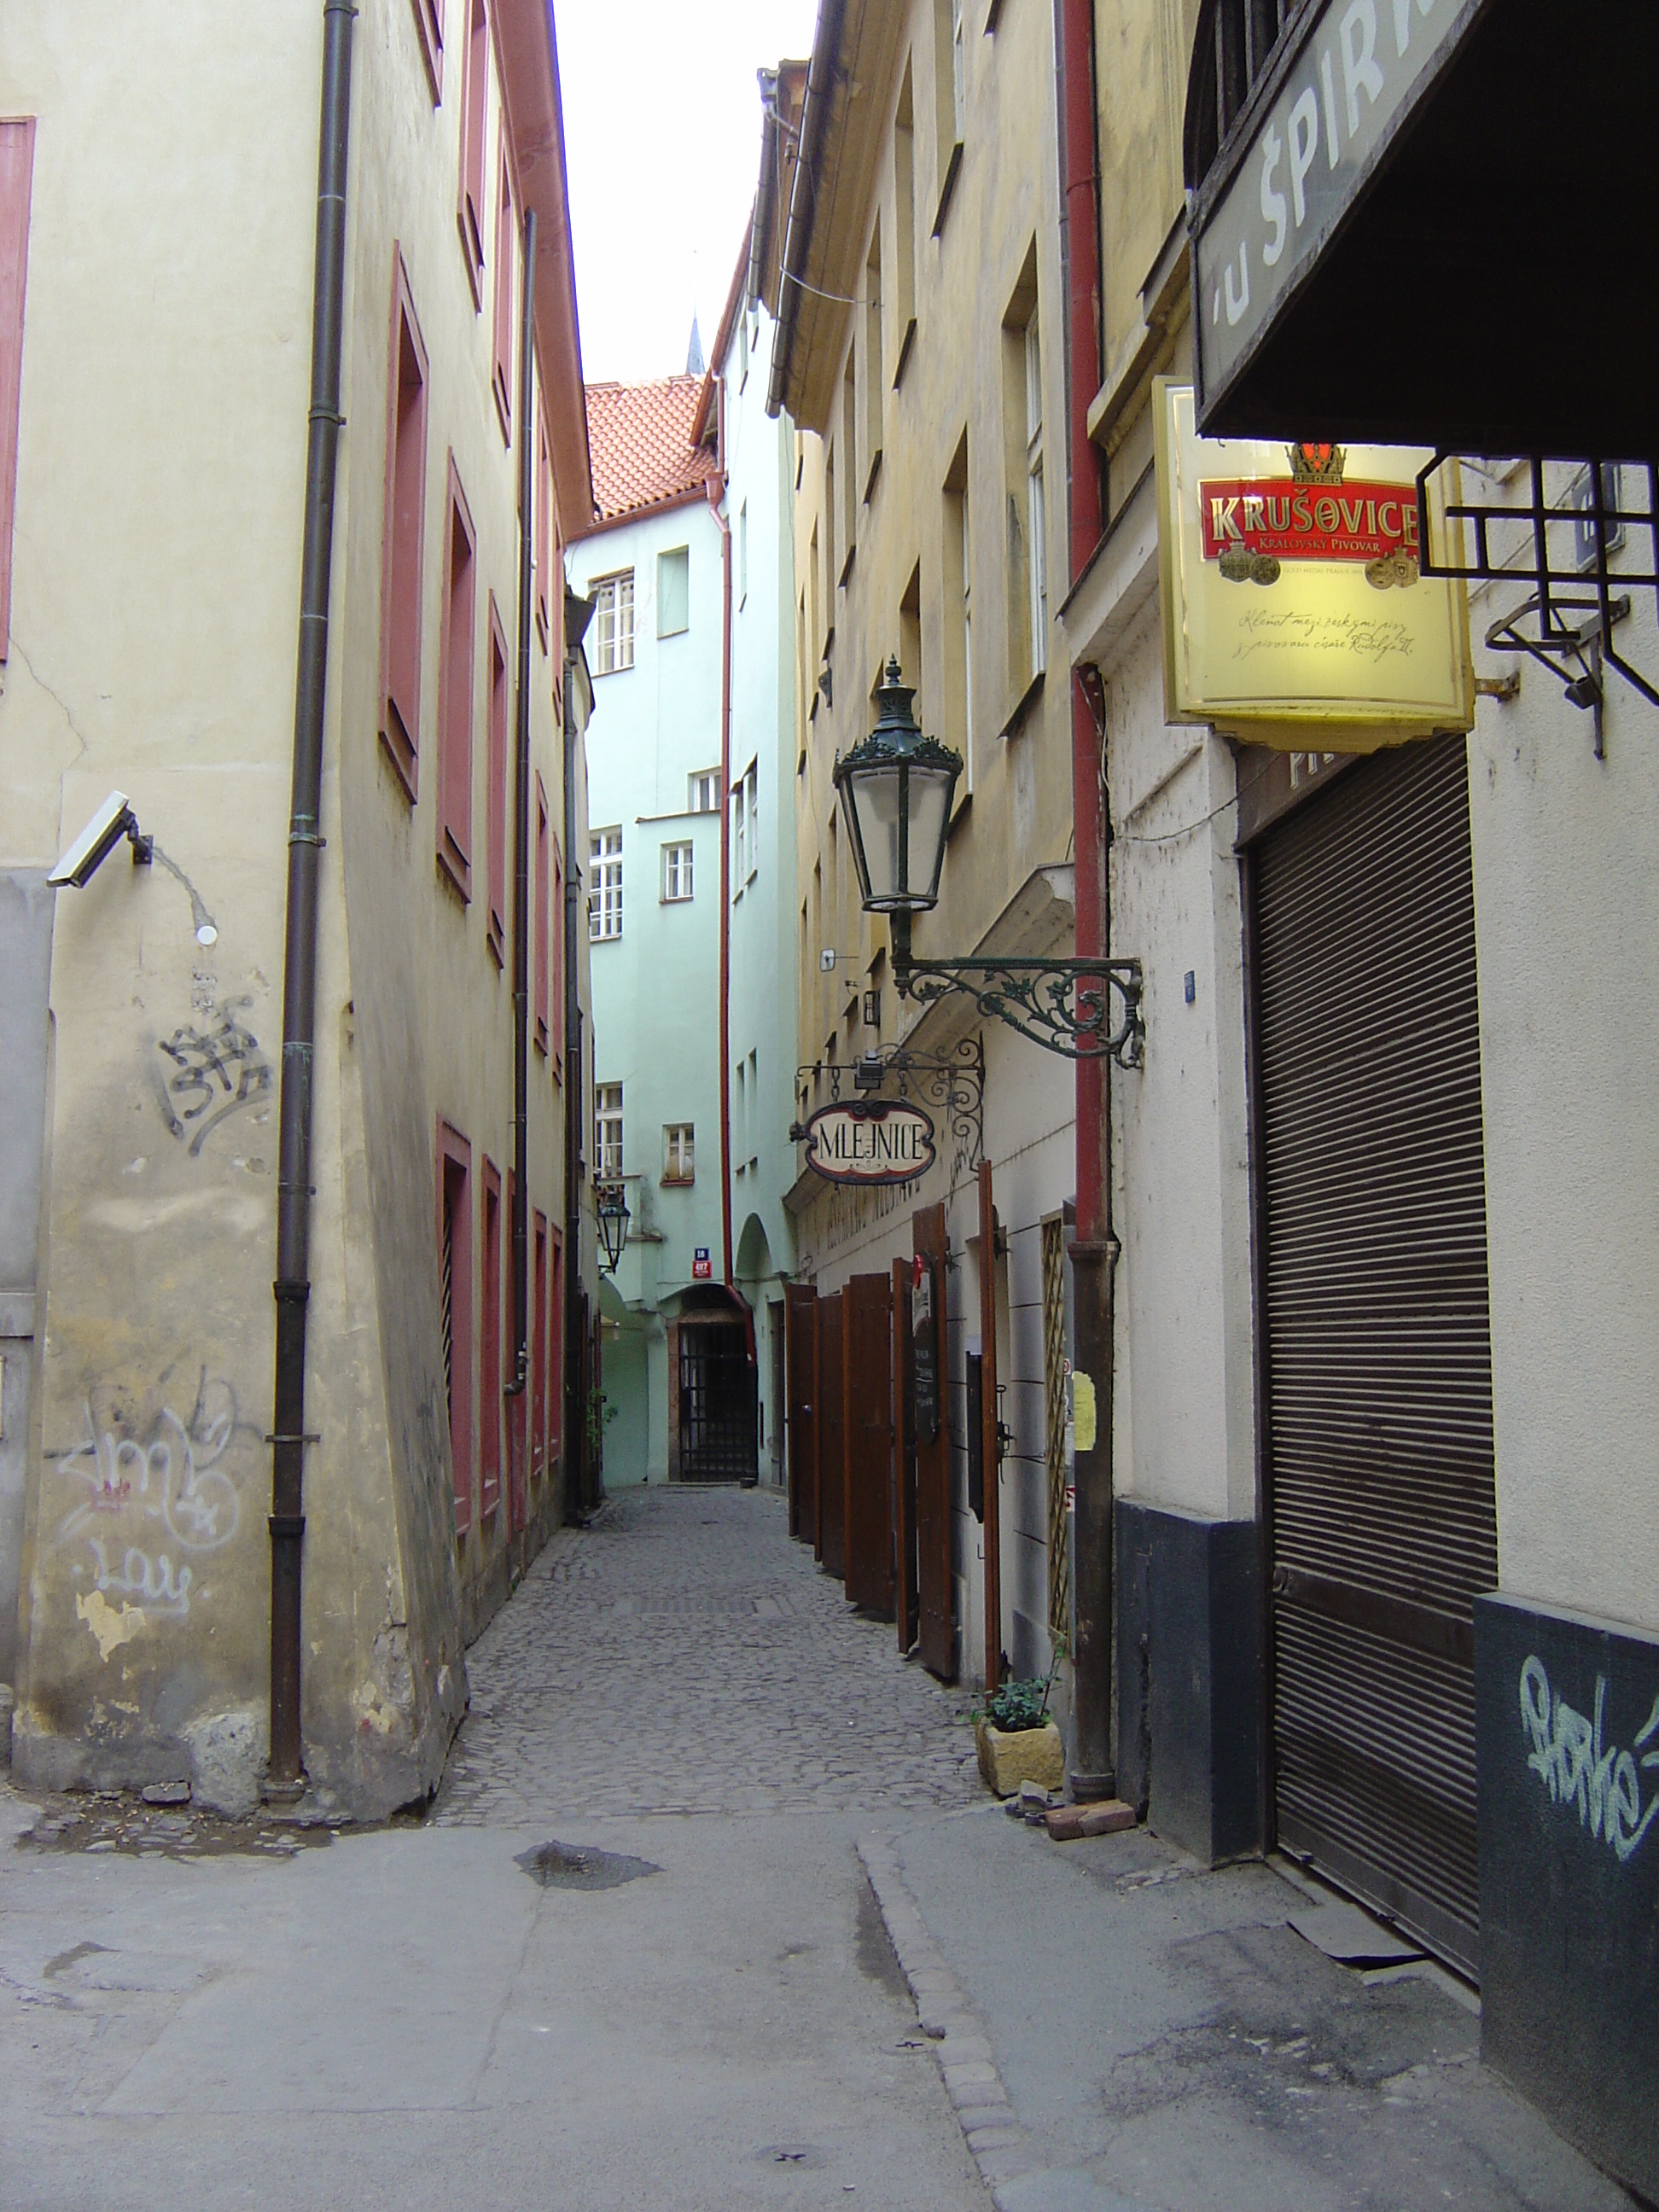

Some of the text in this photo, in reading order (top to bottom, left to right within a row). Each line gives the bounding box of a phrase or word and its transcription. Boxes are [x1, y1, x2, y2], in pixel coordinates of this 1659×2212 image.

[1209, 488, 1418, 547] KRUŠOVICE
[1331, 538, 1381, 553] PIVOVAR
[819, 1122, 923, 1160] MLEJNICE
